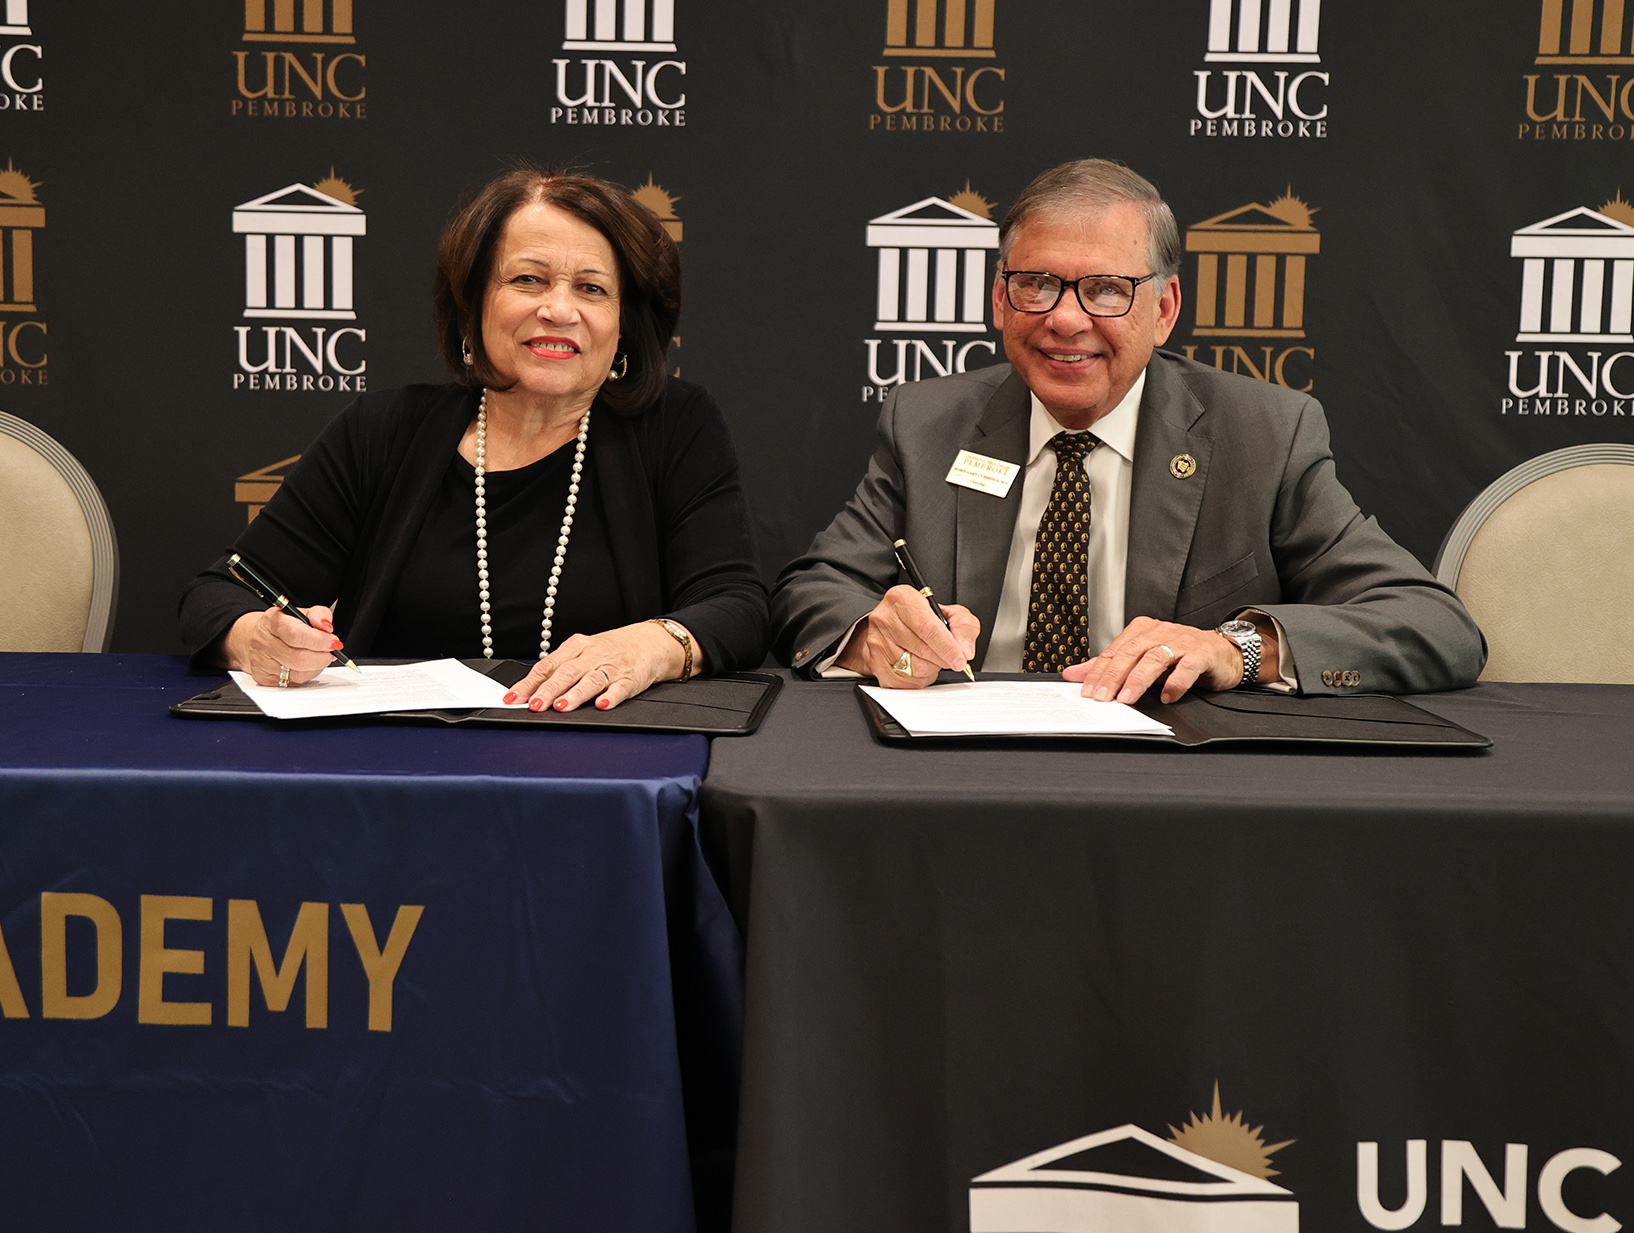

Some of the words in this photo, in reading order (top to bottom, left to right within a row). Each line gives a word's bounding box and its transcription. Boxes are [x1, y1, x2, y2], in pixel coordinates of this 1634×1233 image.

[0, 44, 43, 93] C
[232, 51, 366, 101] UNC
[553, 59, 687, 108] UNC
[873, 66, 1006, 115] UNC
[231, 100, 366, 119] PEMBROKE
[551, 107, 686, 127] PEMBROKE
[1194, 71, 1330, 120] UNC
[869, 114, 1004, 133] PEMBROKE
[1190, 119, 1328, 138] PEMBROKE
[233, 326, 367, 375] UNC
[863, 339, 996, 386] UNC
[1504, 350, 1634, 400] UNC
[232, 373, 367, 393] PEMBROKE
[1357, 1139, 1623, 1233] UNC
